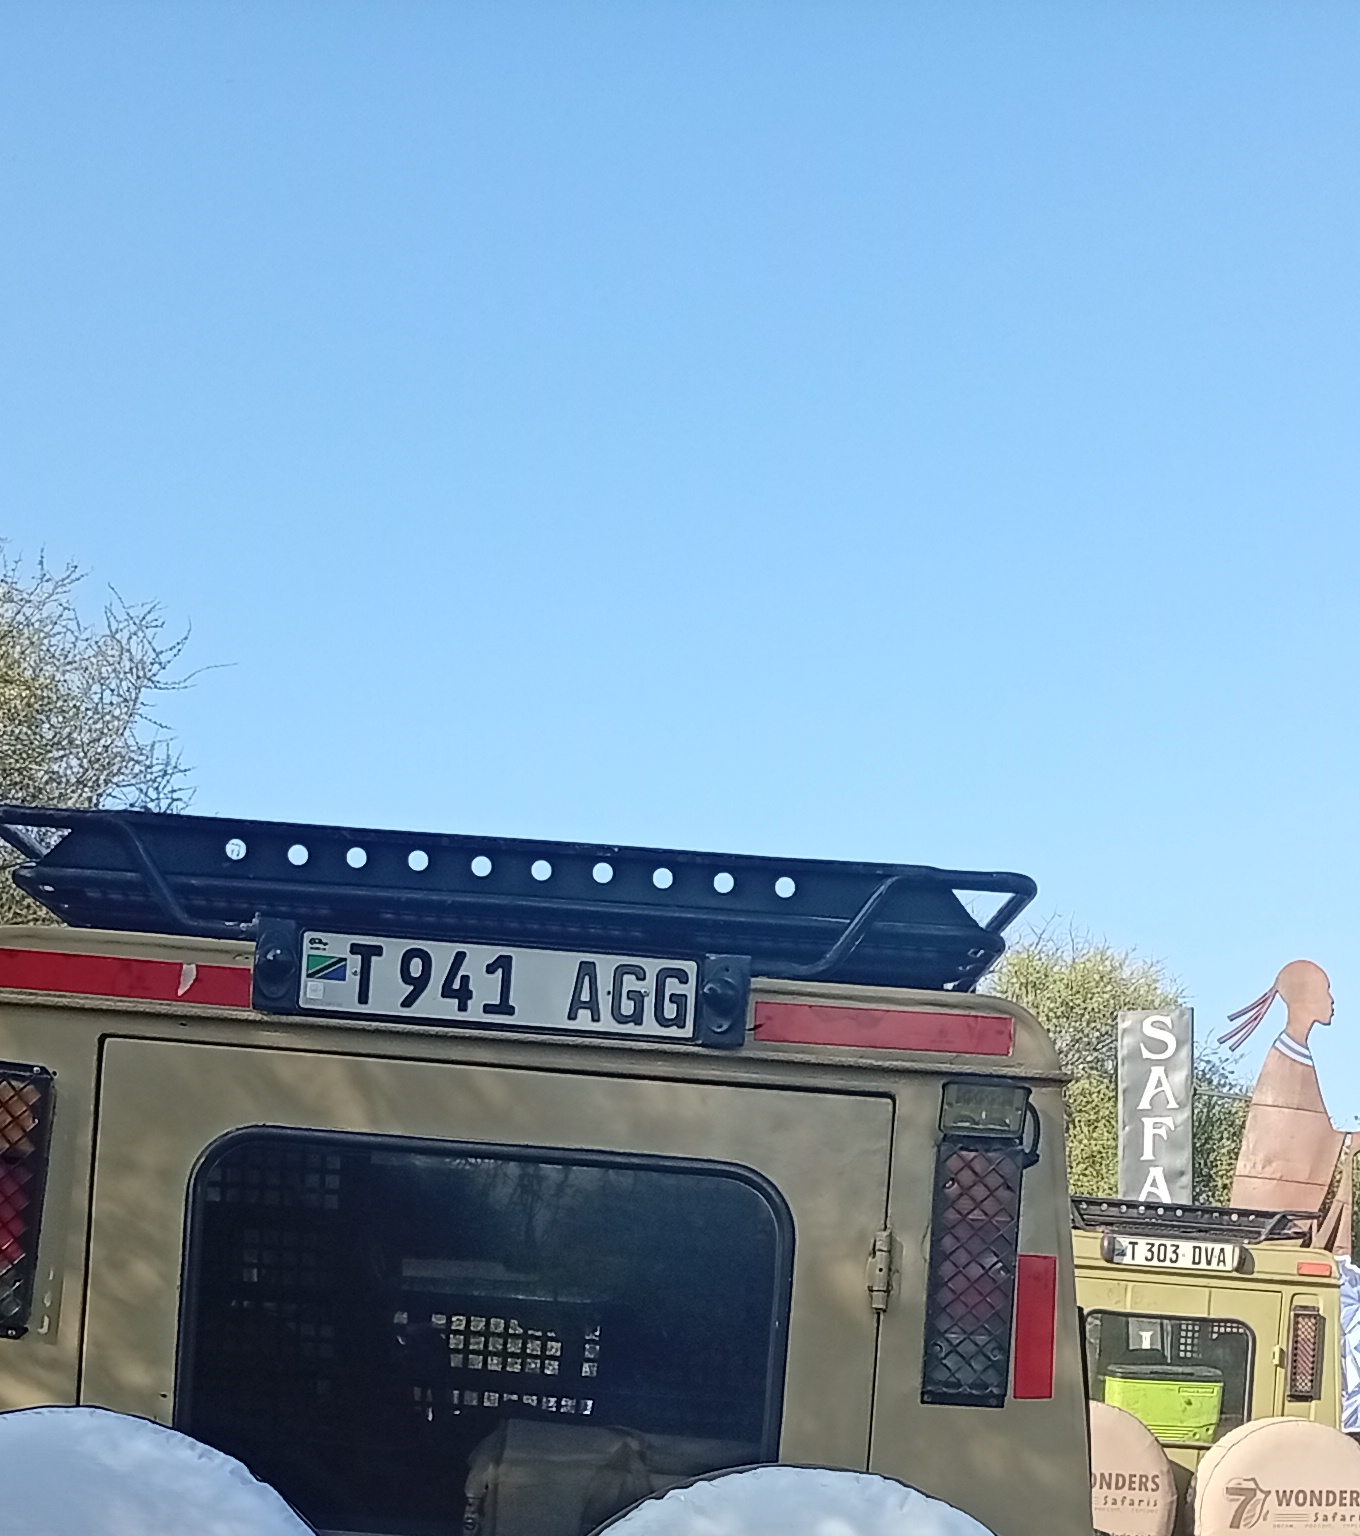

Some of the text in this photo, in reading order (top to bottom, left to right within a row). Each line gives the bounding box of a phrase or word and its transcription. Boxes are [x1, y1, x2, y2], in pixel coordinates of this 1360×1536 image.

[349, 942, 688, 1029] T 941 AGG
[1128, 1241, 1227, 1267] T 303 DVA
[1103, 1495, 1158, 1507] Safaris
